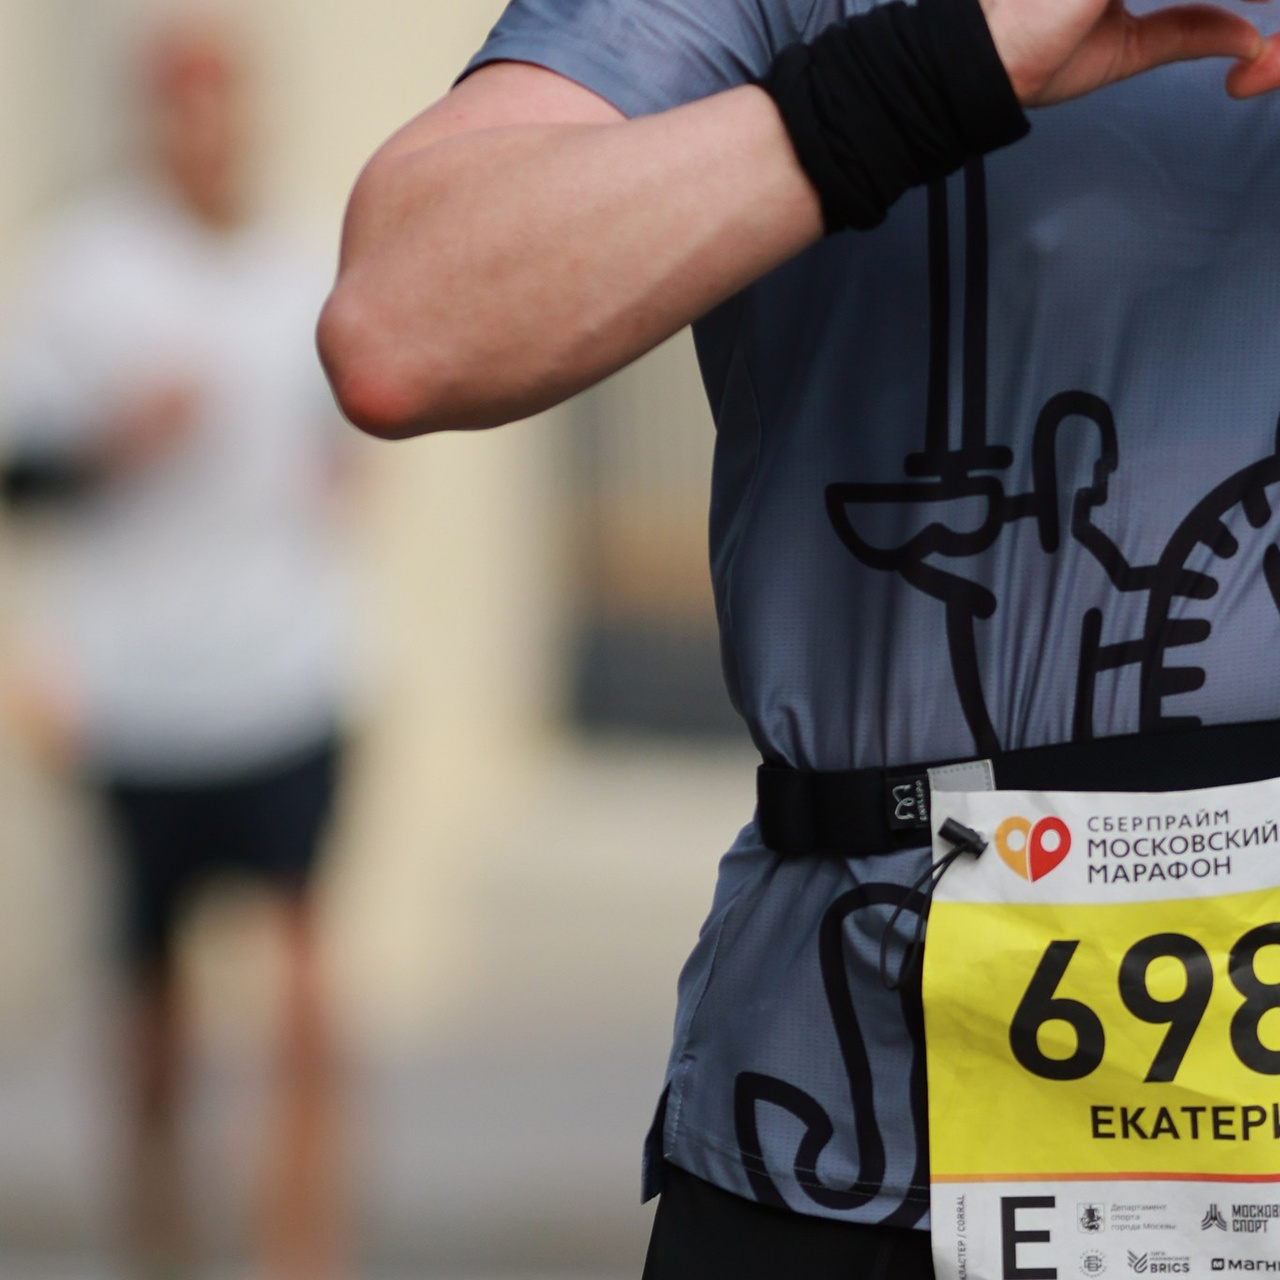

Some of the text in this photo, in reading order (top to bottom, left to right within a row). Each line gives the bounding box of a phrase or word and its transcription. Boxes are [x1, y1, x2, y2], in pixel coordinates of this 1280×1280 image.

[1086, 808, 1231, 833] СБЕРПРАЙМ
[1087, 819, 1279, 859] МОСКОВСКИЙ
[1087, 856, 1232, 885] МАРАФОН
[956, 1194, 967, 1232] CORRAL
[1110, 1202, 1168, 1213] Департамент
[1232, 1219, 1269, 1233] СПОРТ
[1149, 1262, 1191, 1274] BRICS
